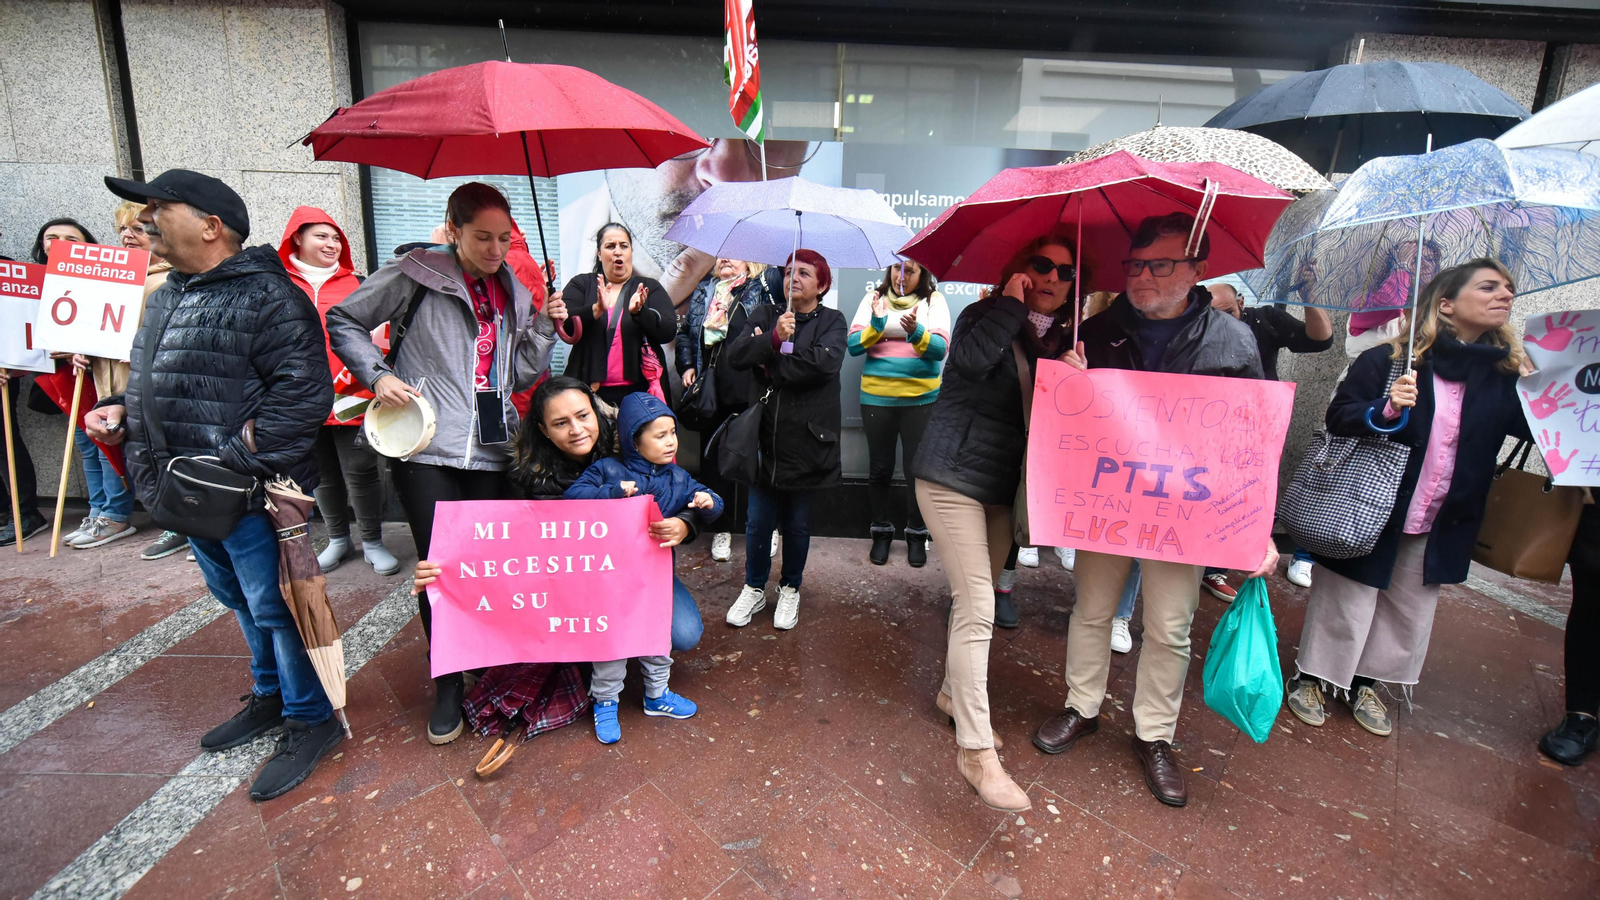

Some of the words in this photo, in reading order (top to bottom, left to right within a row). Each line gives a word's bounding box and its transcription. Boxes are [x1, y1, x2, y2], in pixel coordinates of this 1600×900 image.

[70, 244, 129, 265] CCOO
[57, 262, 136, 281] enseñanza
[51, 290, 78, 326] Ó
[100, 303, 125, 333] N
[1584, 367, 1600, 388] N
[1054, 373, 1255, 431] OSVENTOS
[1058, 434, 1196, 460] ESCUCHA
[1091, 456, 1211, 501] PTIS
[1055, 488, 1132, 513] ESTÁN
[1156, 501, 1194, 521] EN
[473, 522, 511, 540] MI
[539, 520, 609, 541] HIJO
[1063, 511, 1183, 555] LUCHA
[459, 553, 616, 579] NECESITA
[476, 595, 493, 611] A
[512, 592, 548, 609] SU
[548, 615, 609, 633] PTIS
